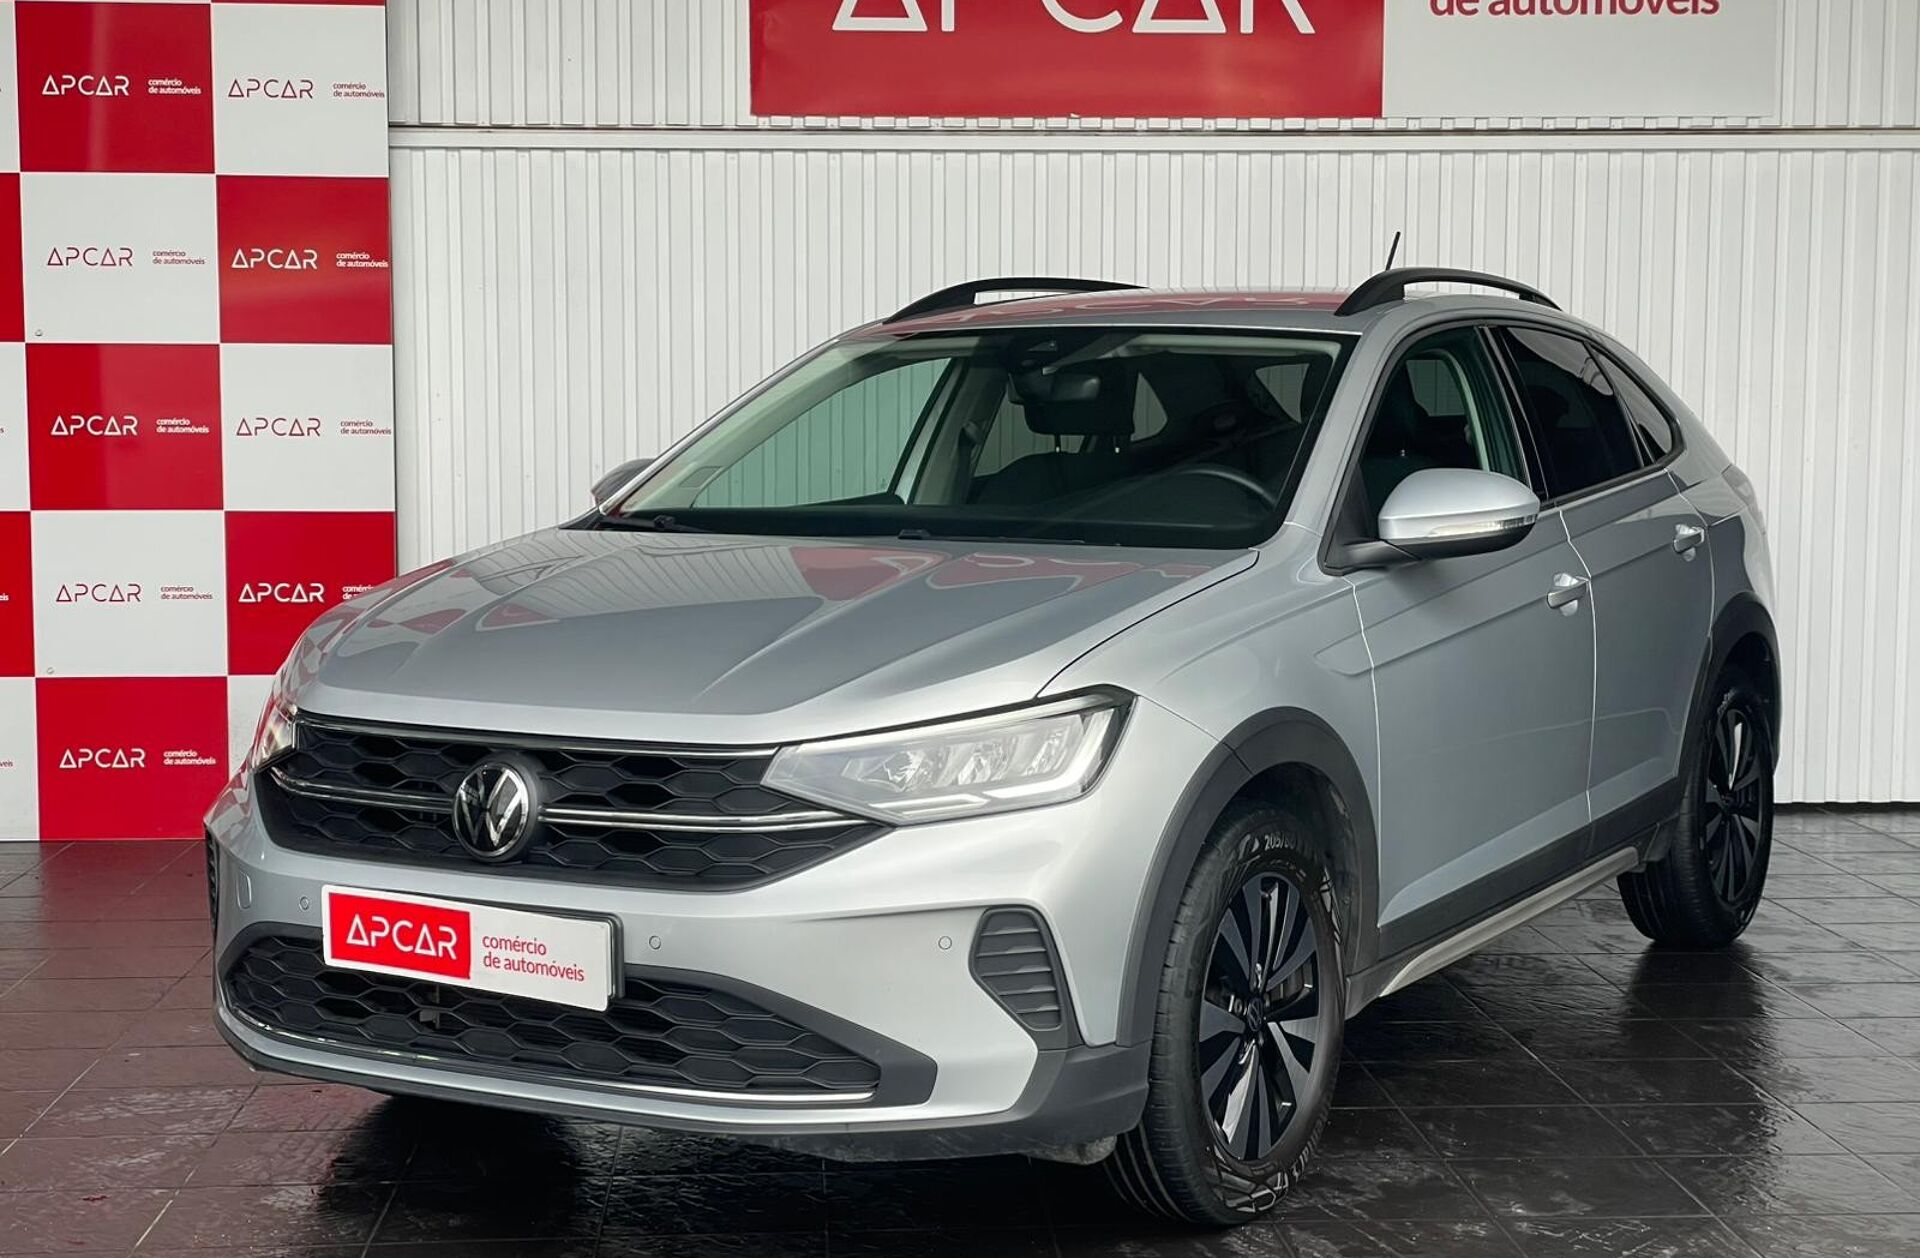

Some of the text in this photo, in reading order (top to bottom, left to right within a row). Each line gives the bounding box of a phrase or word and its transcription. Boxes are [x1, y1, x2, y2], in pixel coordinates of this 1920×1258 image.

[42, 74, 129, 96] APCAR
[148, 86, 158, 95] de
[228, 79, 313, 99] APCAR
[47, 247, 133, 267] APCAR
[231, 248, 318, 269] APCAR
[51, 416, 138, 436] APCAR
[156, 425, 167, 433] de
[236, 418, 320, 437] APCAR
[56, 583, 141, 602] APCAR
[239, 582, 325, 602] APCAR
[59, 748, 146, 768] APCAR
[163, 757, 173, 765] de
[346, 913, 457, 960] APCAR
[482, 935, 547, 956] comércio
[483, 951, 585, 982] de automóveis
